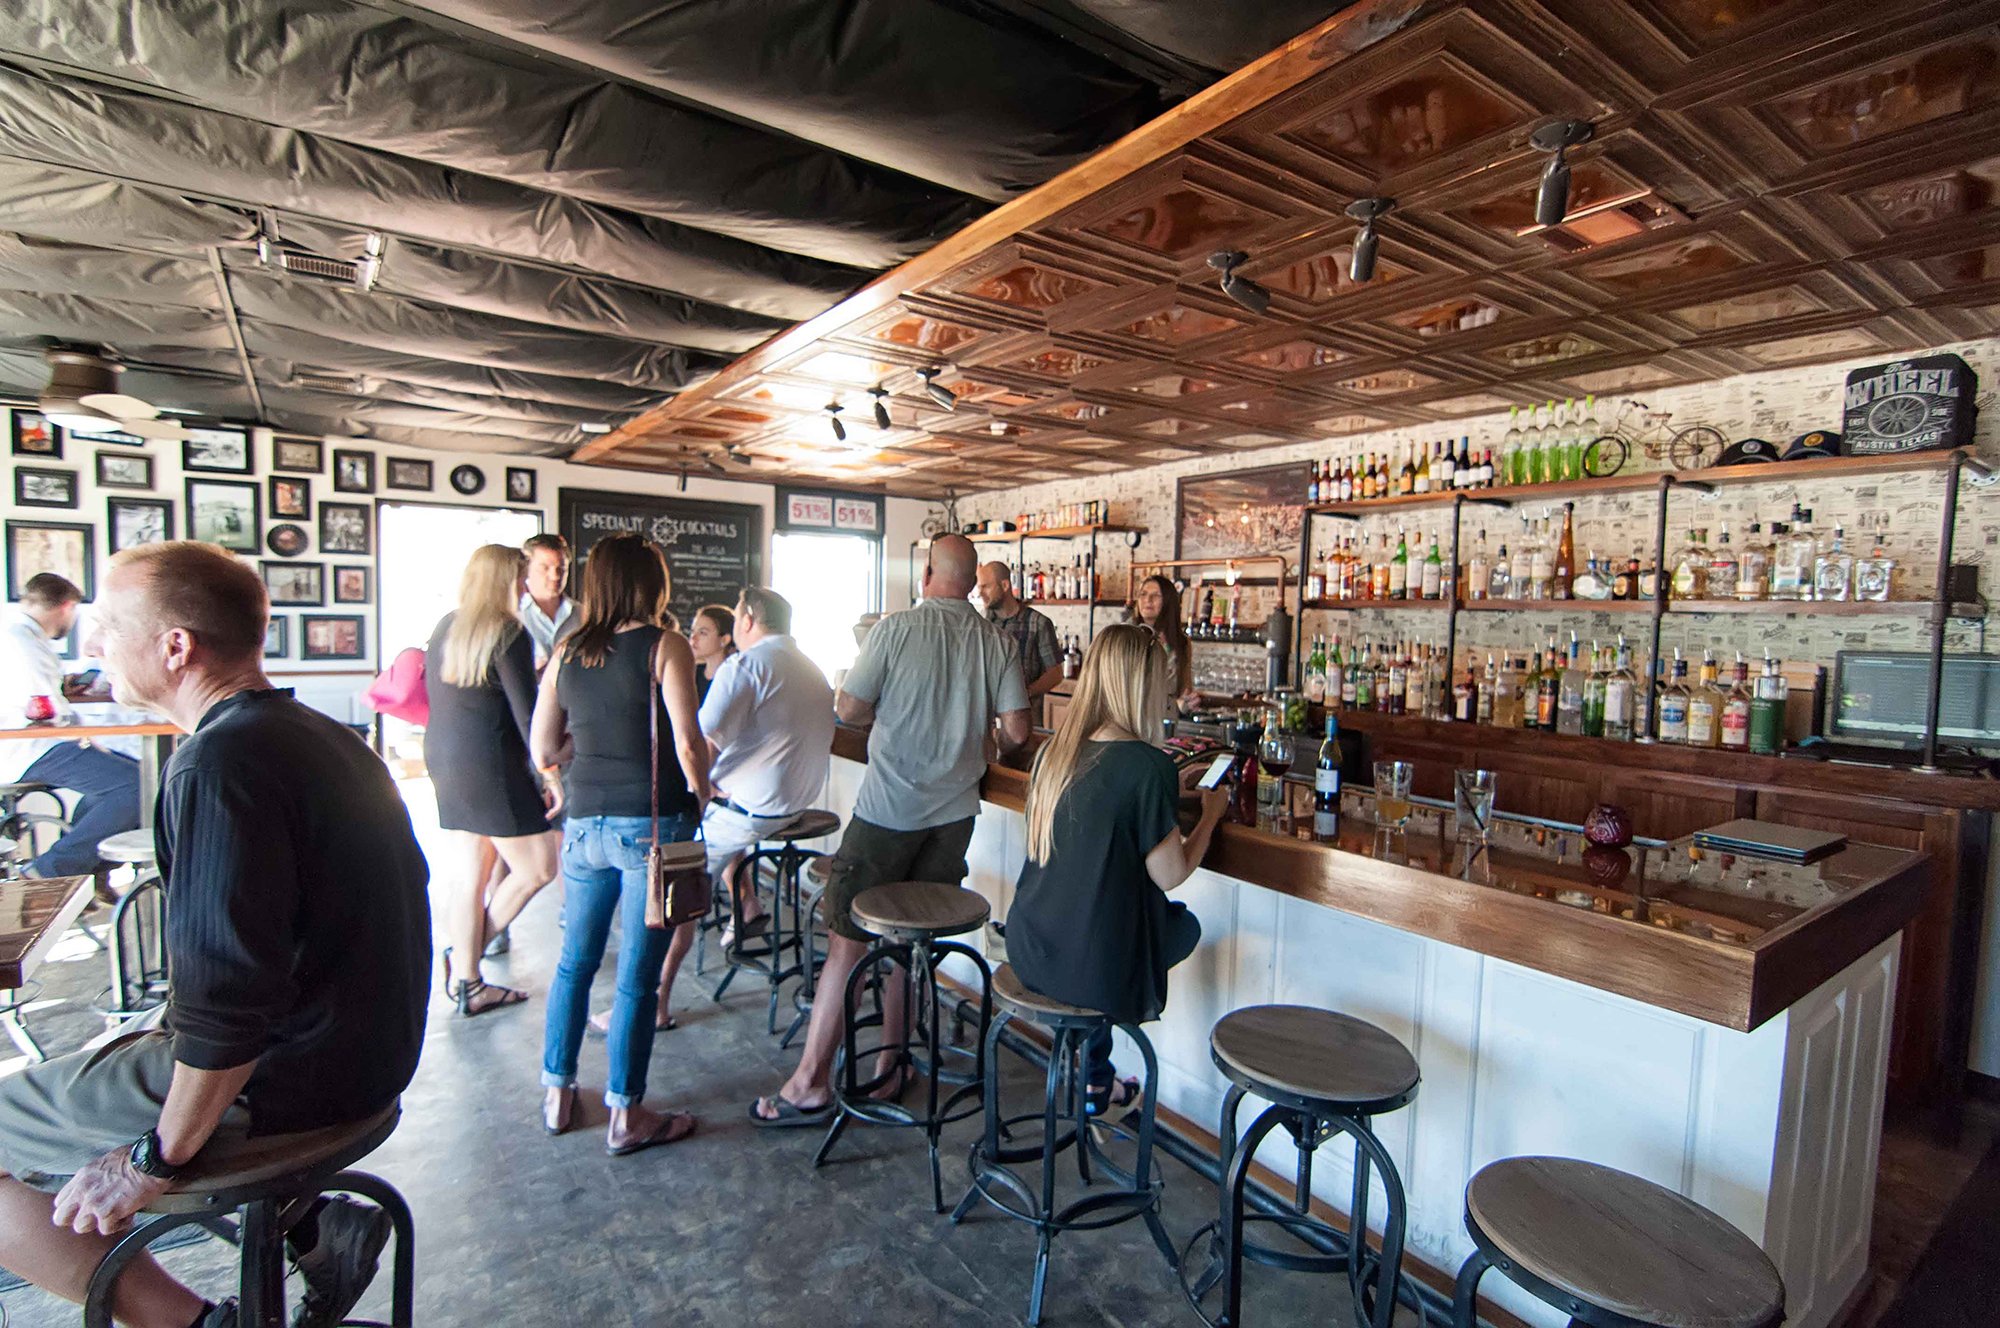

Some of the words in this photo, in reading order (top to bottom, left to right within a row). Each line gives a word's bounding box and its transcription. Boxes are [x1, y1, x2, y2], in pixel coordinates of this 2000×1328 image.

[1846, 368, 1960, 411] WHEEL
[1855, 440, 1897, 450] AUSTIN
[1901, 431, 1938, 446] TEXAS
[792, 502, 830, 520] 51%
[837, 506, 874, 525] 51%
[679, 520, 738, 539] COCKTAILS
